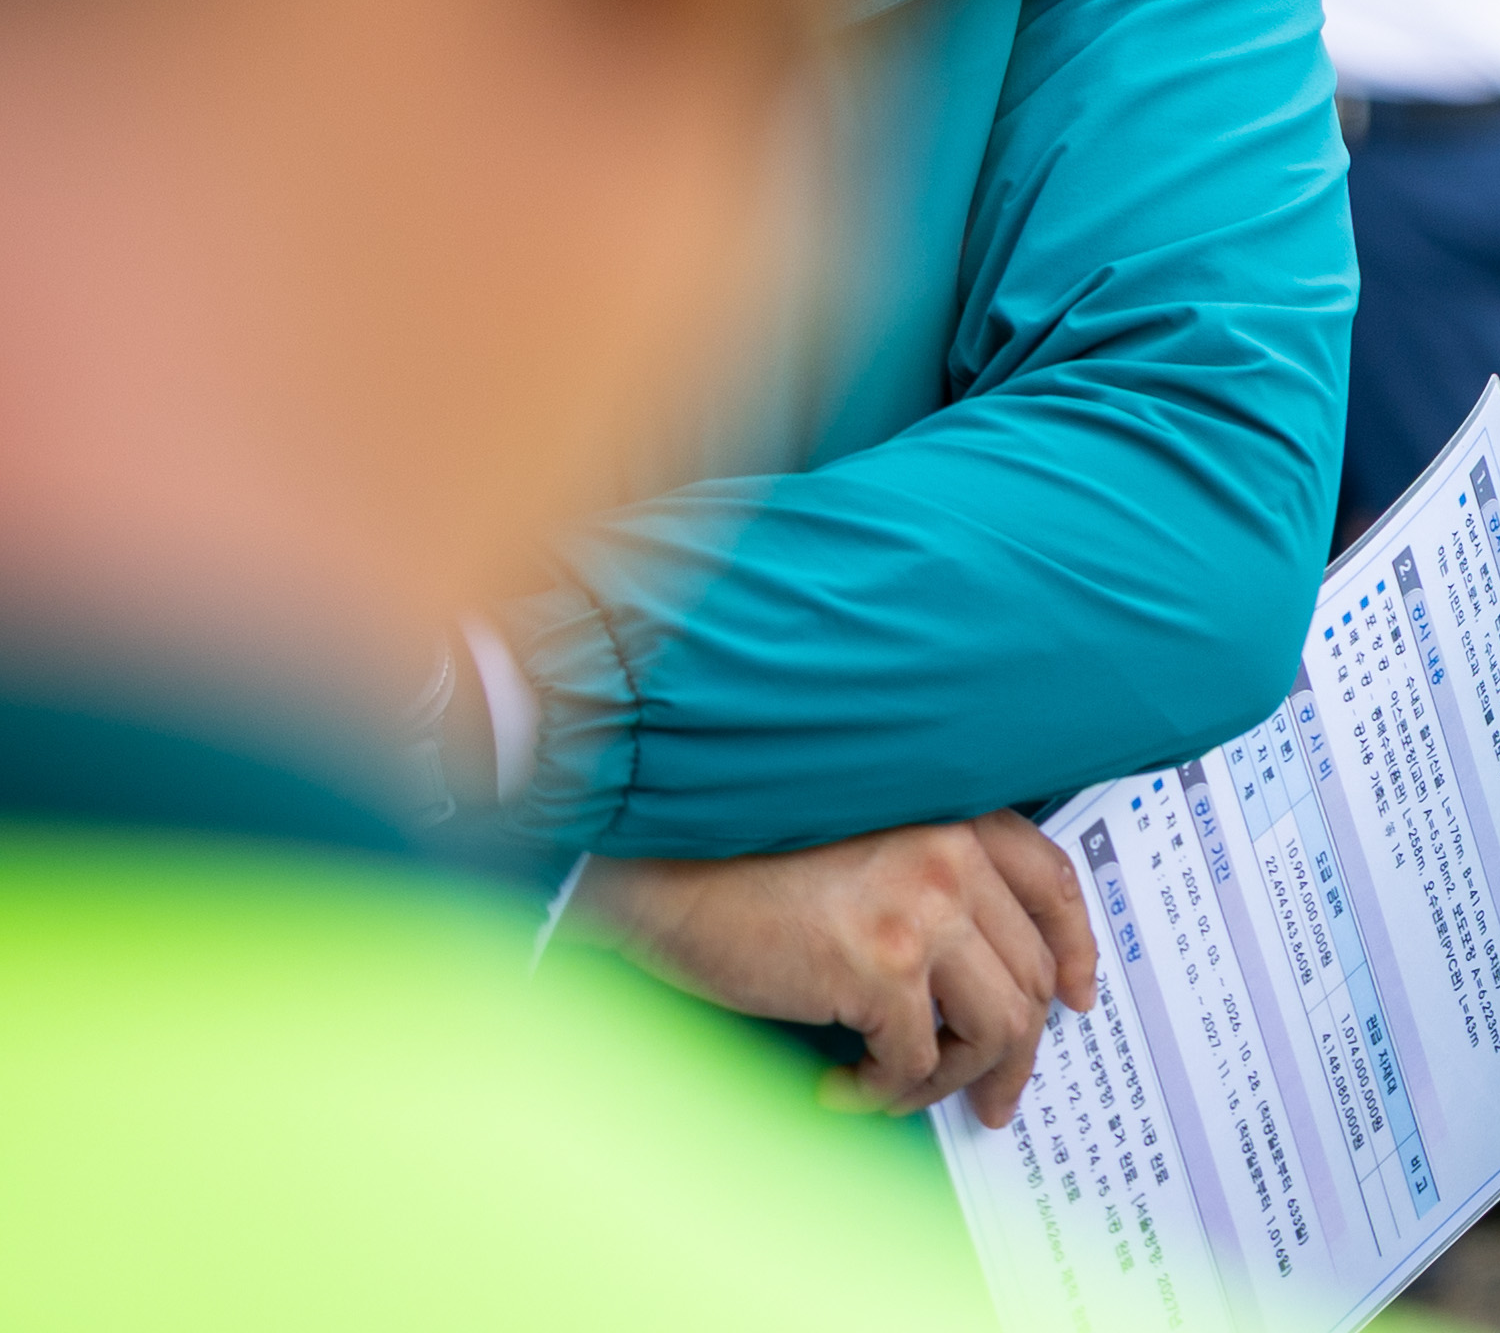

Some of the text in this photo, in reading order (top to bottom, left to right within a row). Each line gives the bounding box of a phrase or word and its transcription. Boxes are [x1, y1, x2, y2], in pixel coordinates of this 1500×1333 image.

[1475, 469, 1487, 493] 1.
[1450, 529, 1483, 623] 시행함으로써,
[1464, 512, 1483, 558] 성남시
[1478, 561, 1498, 606] 분당구
[1397, 557, 1445, 686] 2. 공사 내용
[1436, 543, 1449, 577] 하는
[1446, 582, 1466, 628] 시민의
[1460, 629, 1481, 677] 안전과
[1474, 678, 1495, 726] 편의를
[1352, 720, 1374, 766] 공사용
[1390, 841, 1406, 869] 1식
[1382, 596, 1406, 656] 구조물공
[1404, 675, 1425, 720] 수내교
[1418, 723, 1446, 795] 철거/신설,
[1440, 795, 1467, 865] L=179m,
[1461, 865, 1487, 936] B=41.0m
[1389, 689, 1429, 804] 아스콘포장(교면)
[1422, 807, 1457, 901] A=5,378m2,
[1451, 901, 1477, 962] 보도포장
[1088, 831, 1142, 963] 5. 시공 현황
[1193, 795, 1231, 884] 공사 기간
[1314, 849, 1344, 919] 도급 금액
[1264, 854, 1314, 986] 22,494,943,860원
[1285, 837, 1333, 969] 10,994,000,000원
[1401, 806, 1428, 877] L=258m,
[1422, 879, 1465, 992] 오수관로(PVC관)
[1457, 992, 1480, 1048] L=43m
[1159, 884, 1181, 931] 2025.
[1175, 932, 1190, 961] 02.
[1185, 962, 1200, 991] 03.
[1200, 1010, 1222, 1057] 2027.
[1216, 1058, 1231, 1086] 11.
[1226, 1088, 1240, 1116] 15.
[1234, 1117, 1272, 1213] (착공일로부터
[1265, 1214, 1293, 1278] 1,016일)
[1180, 866, 1202, 912] 2025.
[1196, 913, 1211, 942] 02.
[1206, 943, 1221, 972] 03.
[1221, 992, 1242, 1038] 2026.
[1238, 1039, 1252, 1067] 10.
[1246, 1069, 1262, 1097] 28.
[1255, 1098, 1293, 1194] (착공일로부터
[1286, 1197, 1309, 1246] 633일)
[1321, 1032, 1365, 1152] 4,148,080,000원
[1340, 1012, 1385, 1134] 1,074,000,000원
[1364, 1012, 1398, 1096] 관급 자재대
[1039, 1104, 1057, 1128] A2
[1050, 1133, 1070, 1165] 시공
[1106, 1112, 1126, 1148] 철거
[1139, 1115, 1158, 1147] 시공
[1149, 1151, 1170, 1186] 완료
[1094, 1173, 1111, 1198] P5
[1103, 1203, 1123, 1234] 시공
